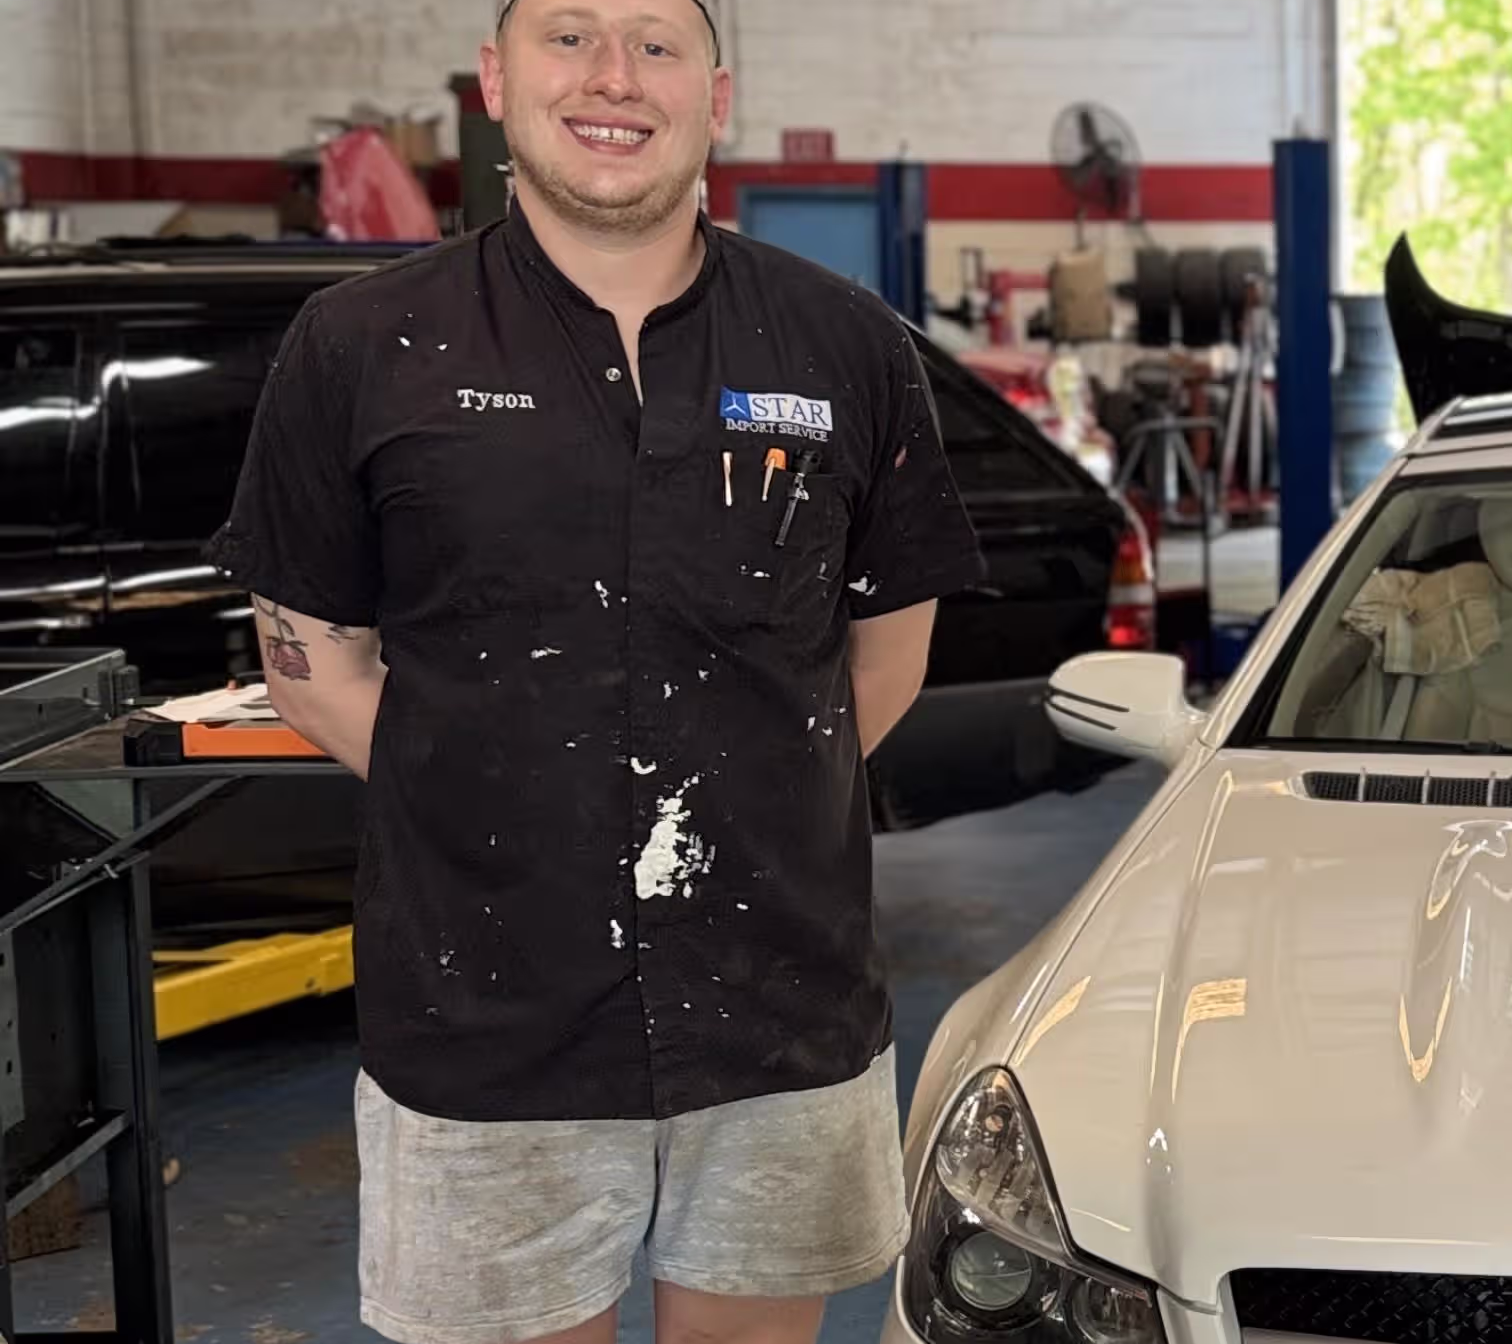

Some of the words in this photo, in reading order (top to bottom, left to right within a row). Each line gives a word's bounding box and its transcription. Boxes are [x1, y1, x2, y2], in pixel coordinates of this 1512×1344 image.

[456, 388, 536, 411] Tyson
[751, 397, 829, 426] STAR
[725, 418, 776, 434] IMPORT
[778, 422, 829, 442] SERVICE
